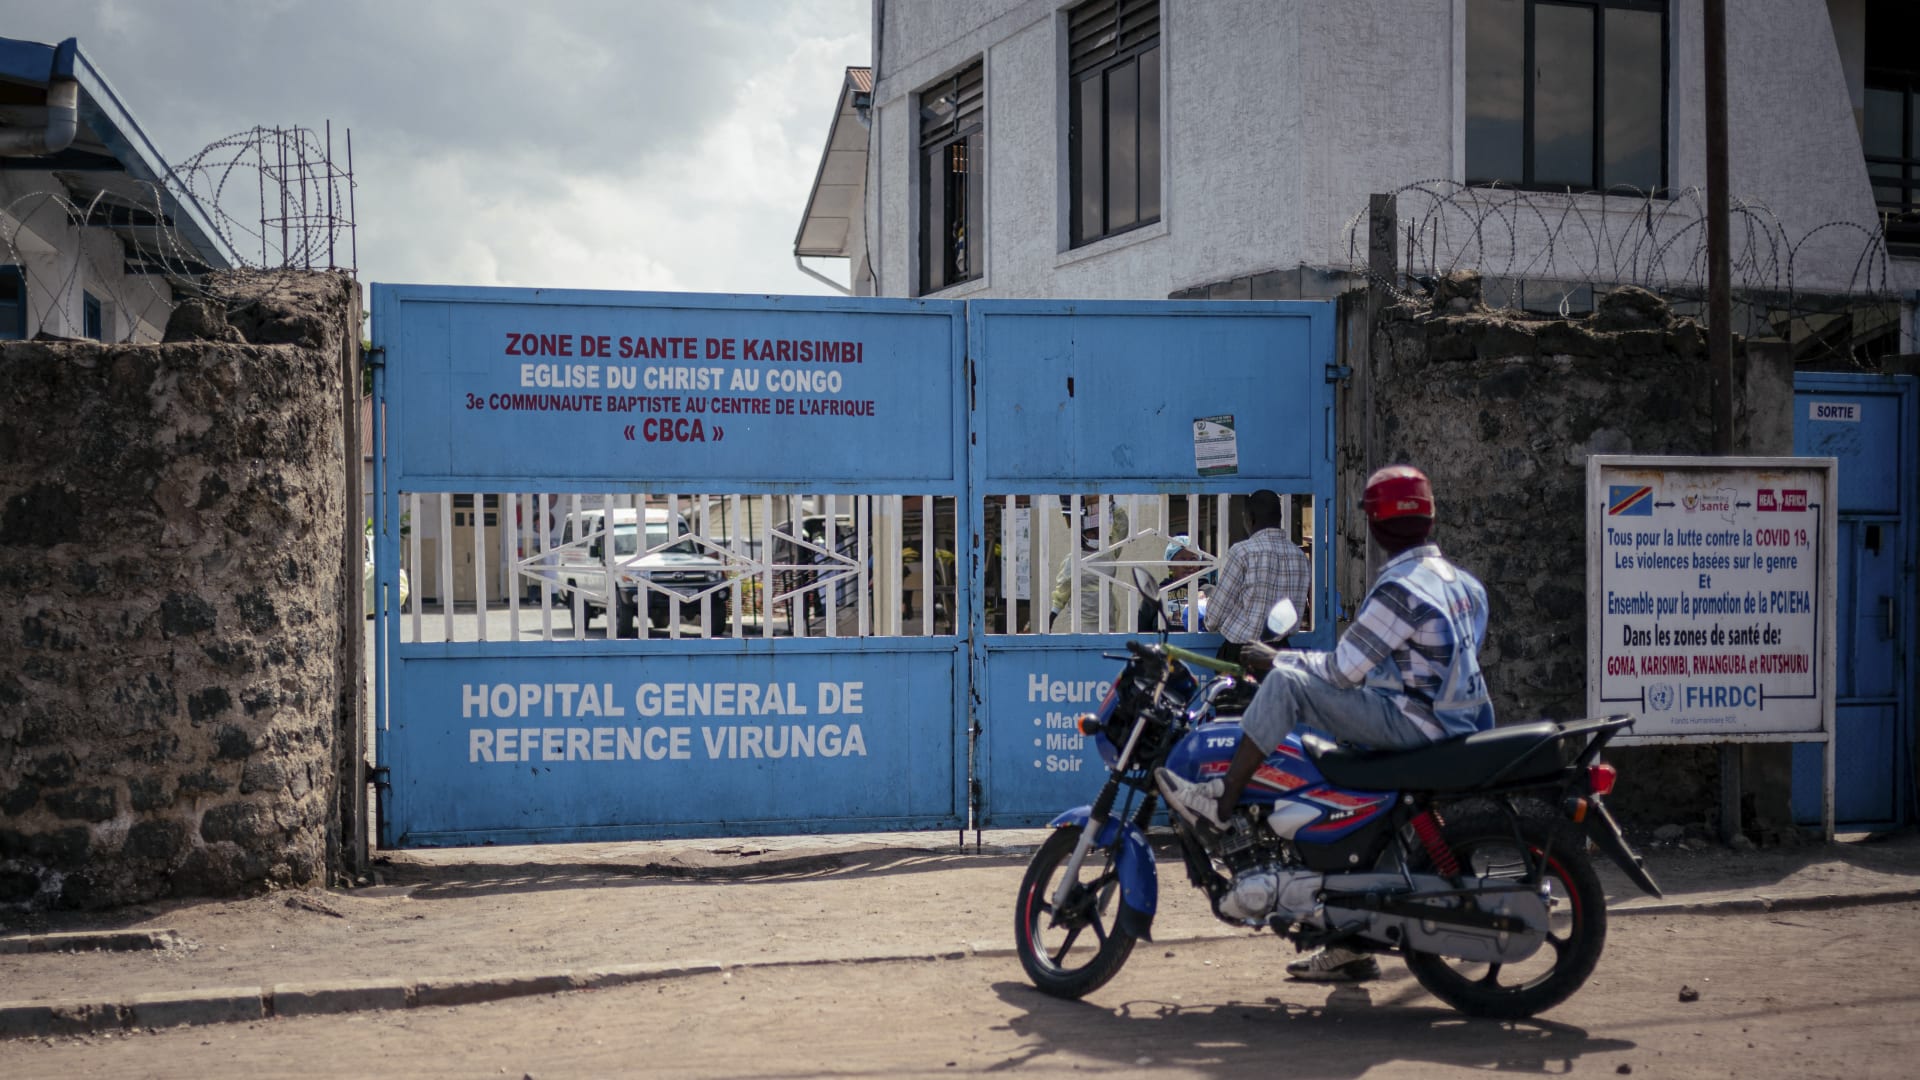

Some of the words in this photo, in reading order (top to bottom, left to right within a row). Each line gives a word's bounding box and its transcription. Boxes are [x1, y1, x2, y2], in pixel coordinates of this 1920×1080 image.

[505, 332, 573, 357] ZONE
[580, 335, 611, 357] DE
[619, 336, 698, 359] SANTE
[705, 337, 735, 360] DE
[743, 339, 863, 363] KARISIMBI
[520, 363, 600, 388] EGLISE
[606, 366, 635, 389] DU
[643, 366, 725, 390] CHRIST
[730, 368, 760, 391] AU
[766, 369, 842, 393] CONGO
[466, 393, 484, 410] 3e
[489, 393, 602, 412] COMMUNAUTE
[607, 395, 681, 414] BAPTISTE
[686, 397, 707, 414] AU
[711, 396, 770, 415] CENTRE
[775, 398, 795, 416] DE
[1817, 405, 1854, 419] SORTIE
[642, 417, 705, 443] CBCA
[1701, 500, 1729, 511] santé
[1759, 494, 1775, 507] HEAL
[1784, 494, 1807, 507] AFRICA
[1607, 528, 1633, 546] Tous
[1636, 532, 1661, 551] pour
[1664, 528, 1674, 546] la
[1677, 528, 1703, 546] lutte
[1705, 529, 1740, 546] contre
[1743, 528, 1753, 546] la
[1756, 528, 1790, 546] COVID
[1794, 529, 1810, 551] 19,
[1615, 551, 1634, 569] Les
[1637, 551, 1690, 569] violences
[1692, 551, 1730, 569] basées
[1733, 555, 1751, 569] sur
[1753, 551, 1763, 569] le
[1766, 555, 1798, 573] genre
[1699, 573, 1712, 589] Et
[1608, 591, 1655, 615] Ensemble
[1657, 597, 1679, 621] pour
[1681, 591, 1690, 615] la
[1692, 591, 1741, 620] promotion
[1744, 591, 1756, 614] de
[1759, 591, 1768, 614] la
[1623, 624, 1652, 646] Dans
[1655, 623, 1671, 646] les
[1673, 629, 1708, 646] zones
[1711, 623, 1725, 646] de
[1728, 622, 1760, 646] santé
[1763, 622, 1782, 645] de:
[1607, 655, 1639, 679] GOMA,
[1641, 655, 1691, 678] KARISIMBI,
[1693, 654, 1747, 675] RWANGUBA
[1749, 656, 1759, 675] et
[1760, 654, 1809, 674] RUTSHURU
[462, 683, 625, 718] HOPITAL
[635, 682, 807, 717] GENERAL
[818, 681, 864, 715] DE
[1686, 685, 1757, 708] FHRDC
[1046, 712, 1086, 729] Mat
[469, 727, 691, 763] REFERENCE
[702, 724, 867, 760] VIRUNGA
[1046, 733, 1083, 750] Midi
[1207, 737, 1235, 748] TVS
[1046, 755, 1083, 772] Soir
